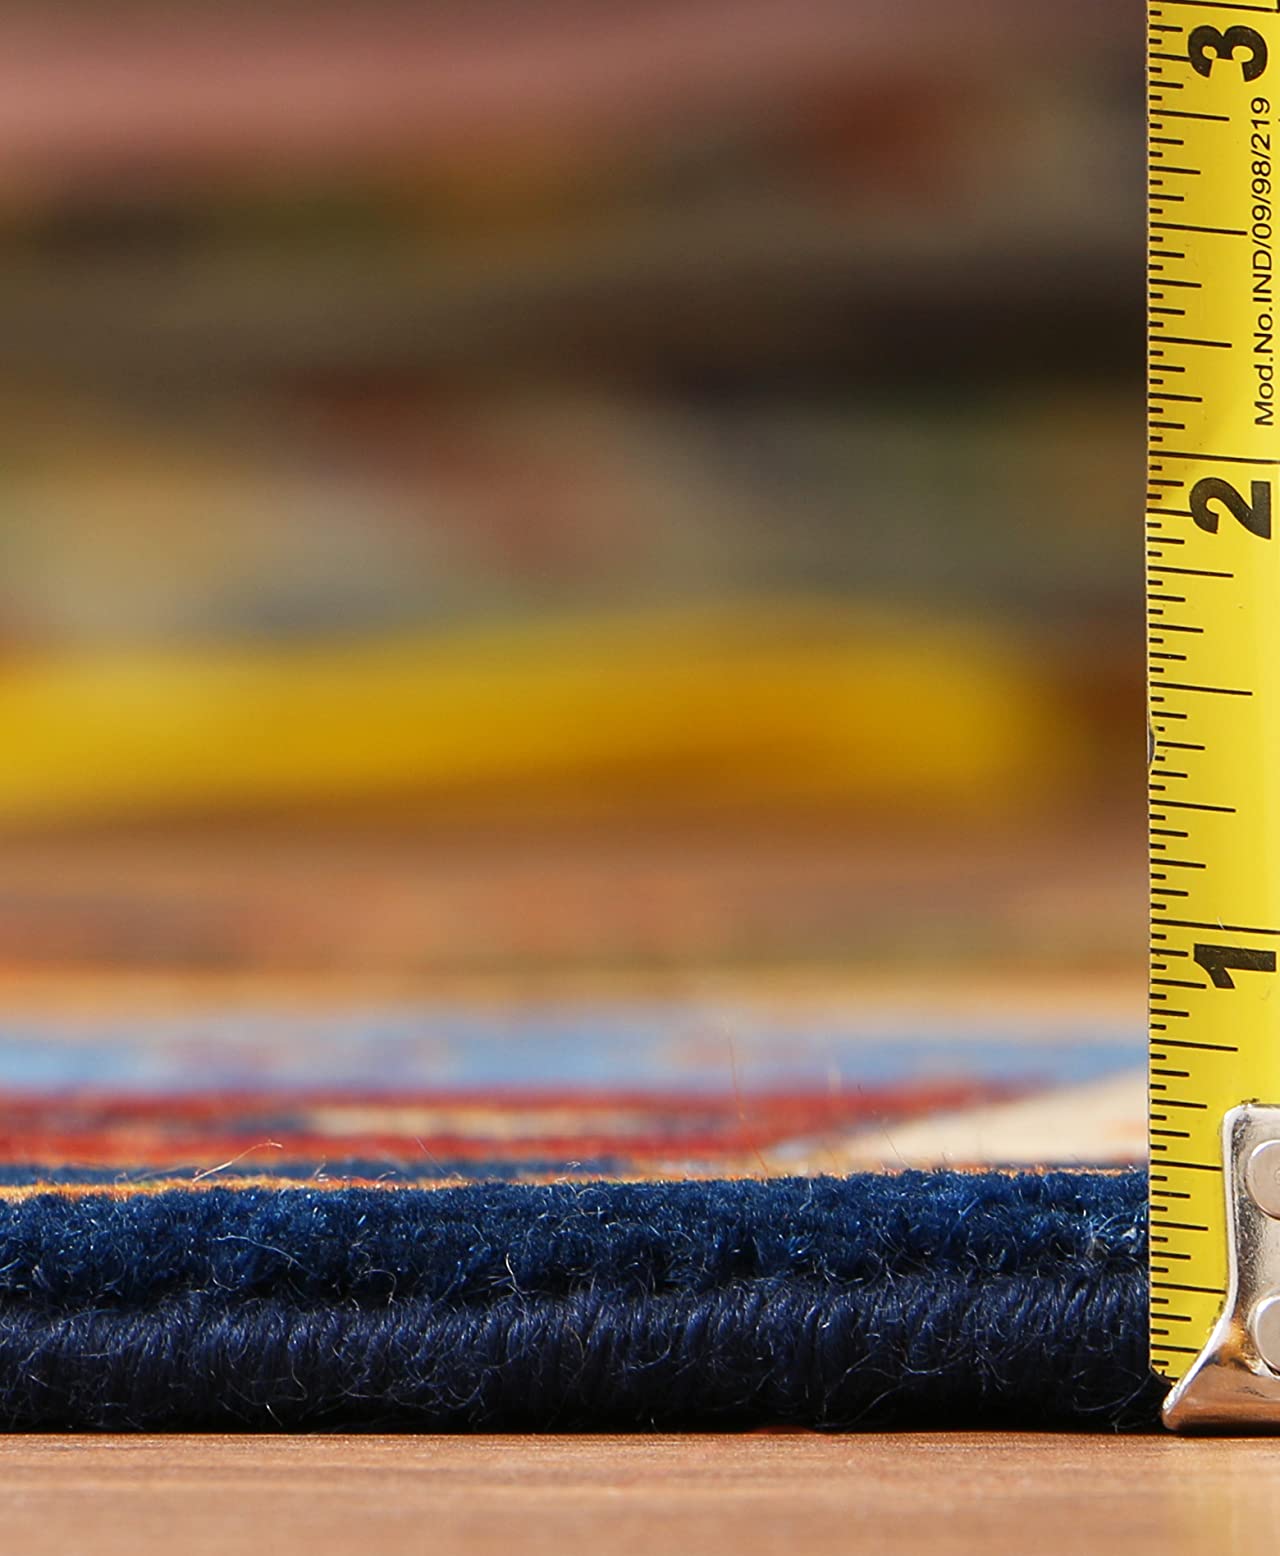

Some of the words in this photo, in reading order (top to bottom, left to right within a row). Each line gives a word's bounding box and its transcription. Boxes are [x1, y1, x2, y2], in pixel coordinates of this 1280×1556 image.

[1187, 25, 1268, 82] 3
[1250, 97, 1274, 426] Mod.No.IND/09/98/219
[1189, 477, 1271, 540] 2
[1193, 943, 1276, 989] 1
